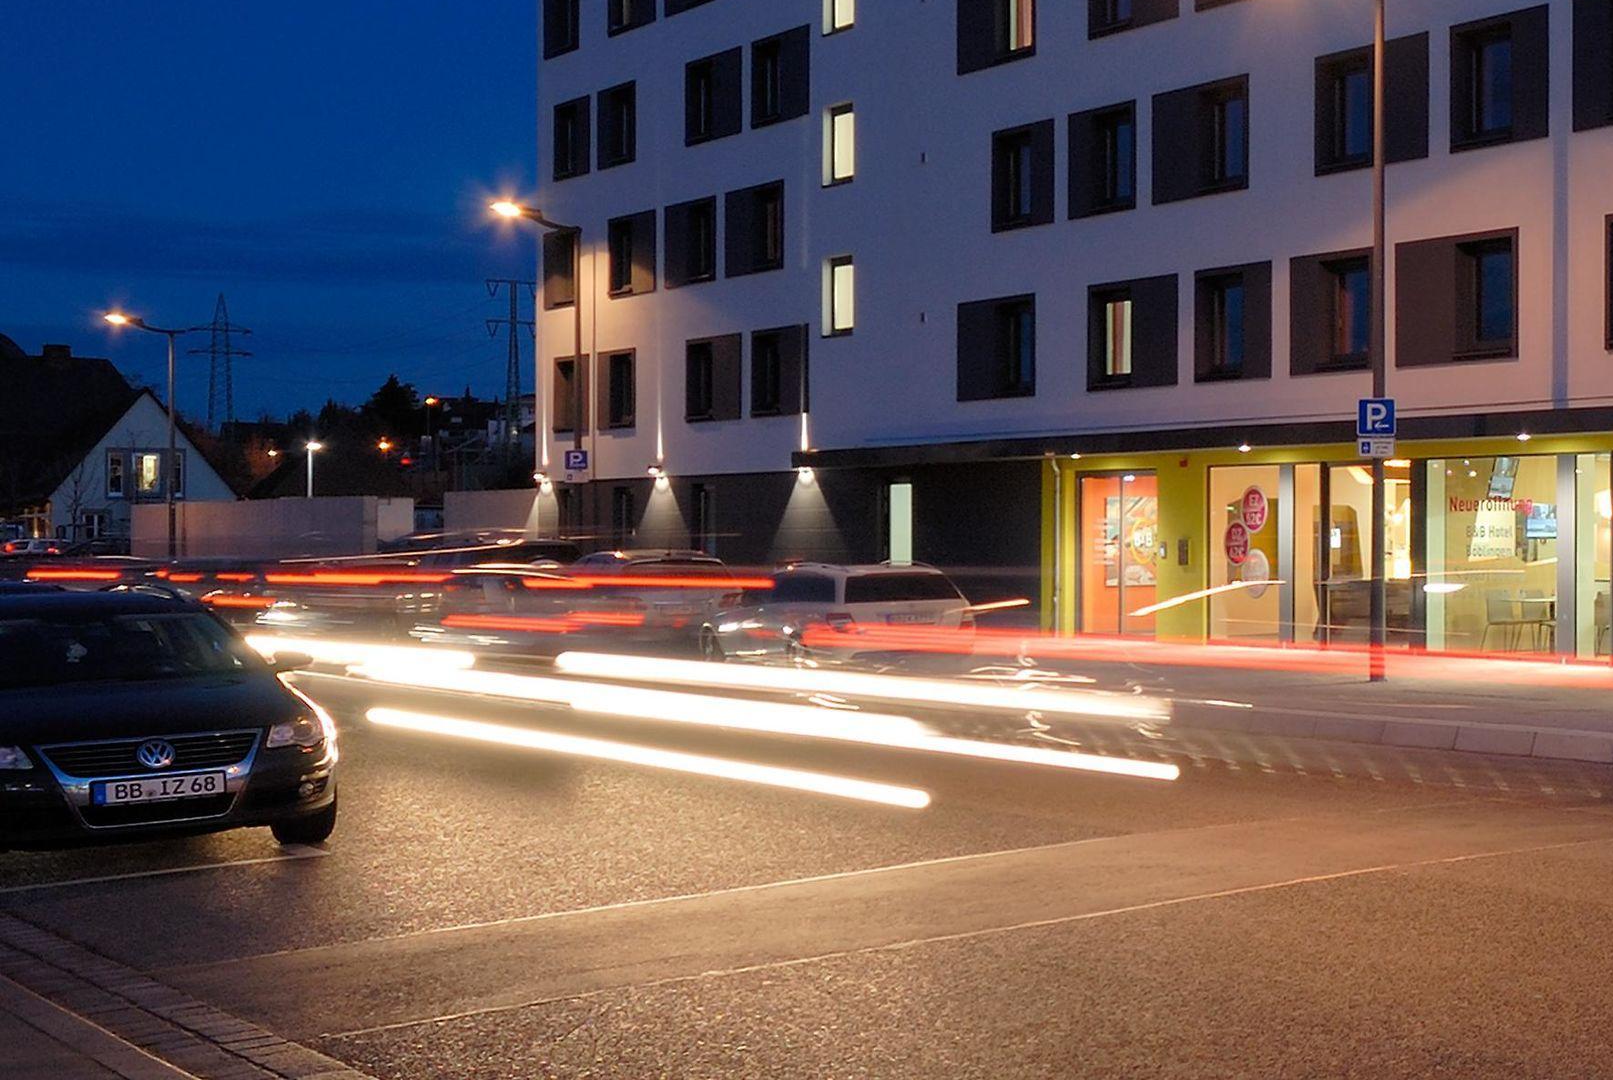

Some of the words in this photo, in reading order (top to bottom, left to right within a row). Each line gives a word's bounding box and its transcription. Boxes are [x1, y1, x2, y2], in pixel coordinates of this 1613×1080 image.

[1366, 403, 1387, 430] P
[570, 452, 583, 468] P
[1488, 524, 1513, 538] Hotel
[115, 782, 142, 800] BB
[160, 779, 186, 796] IZ
[190, 776, 216, 793] 68
